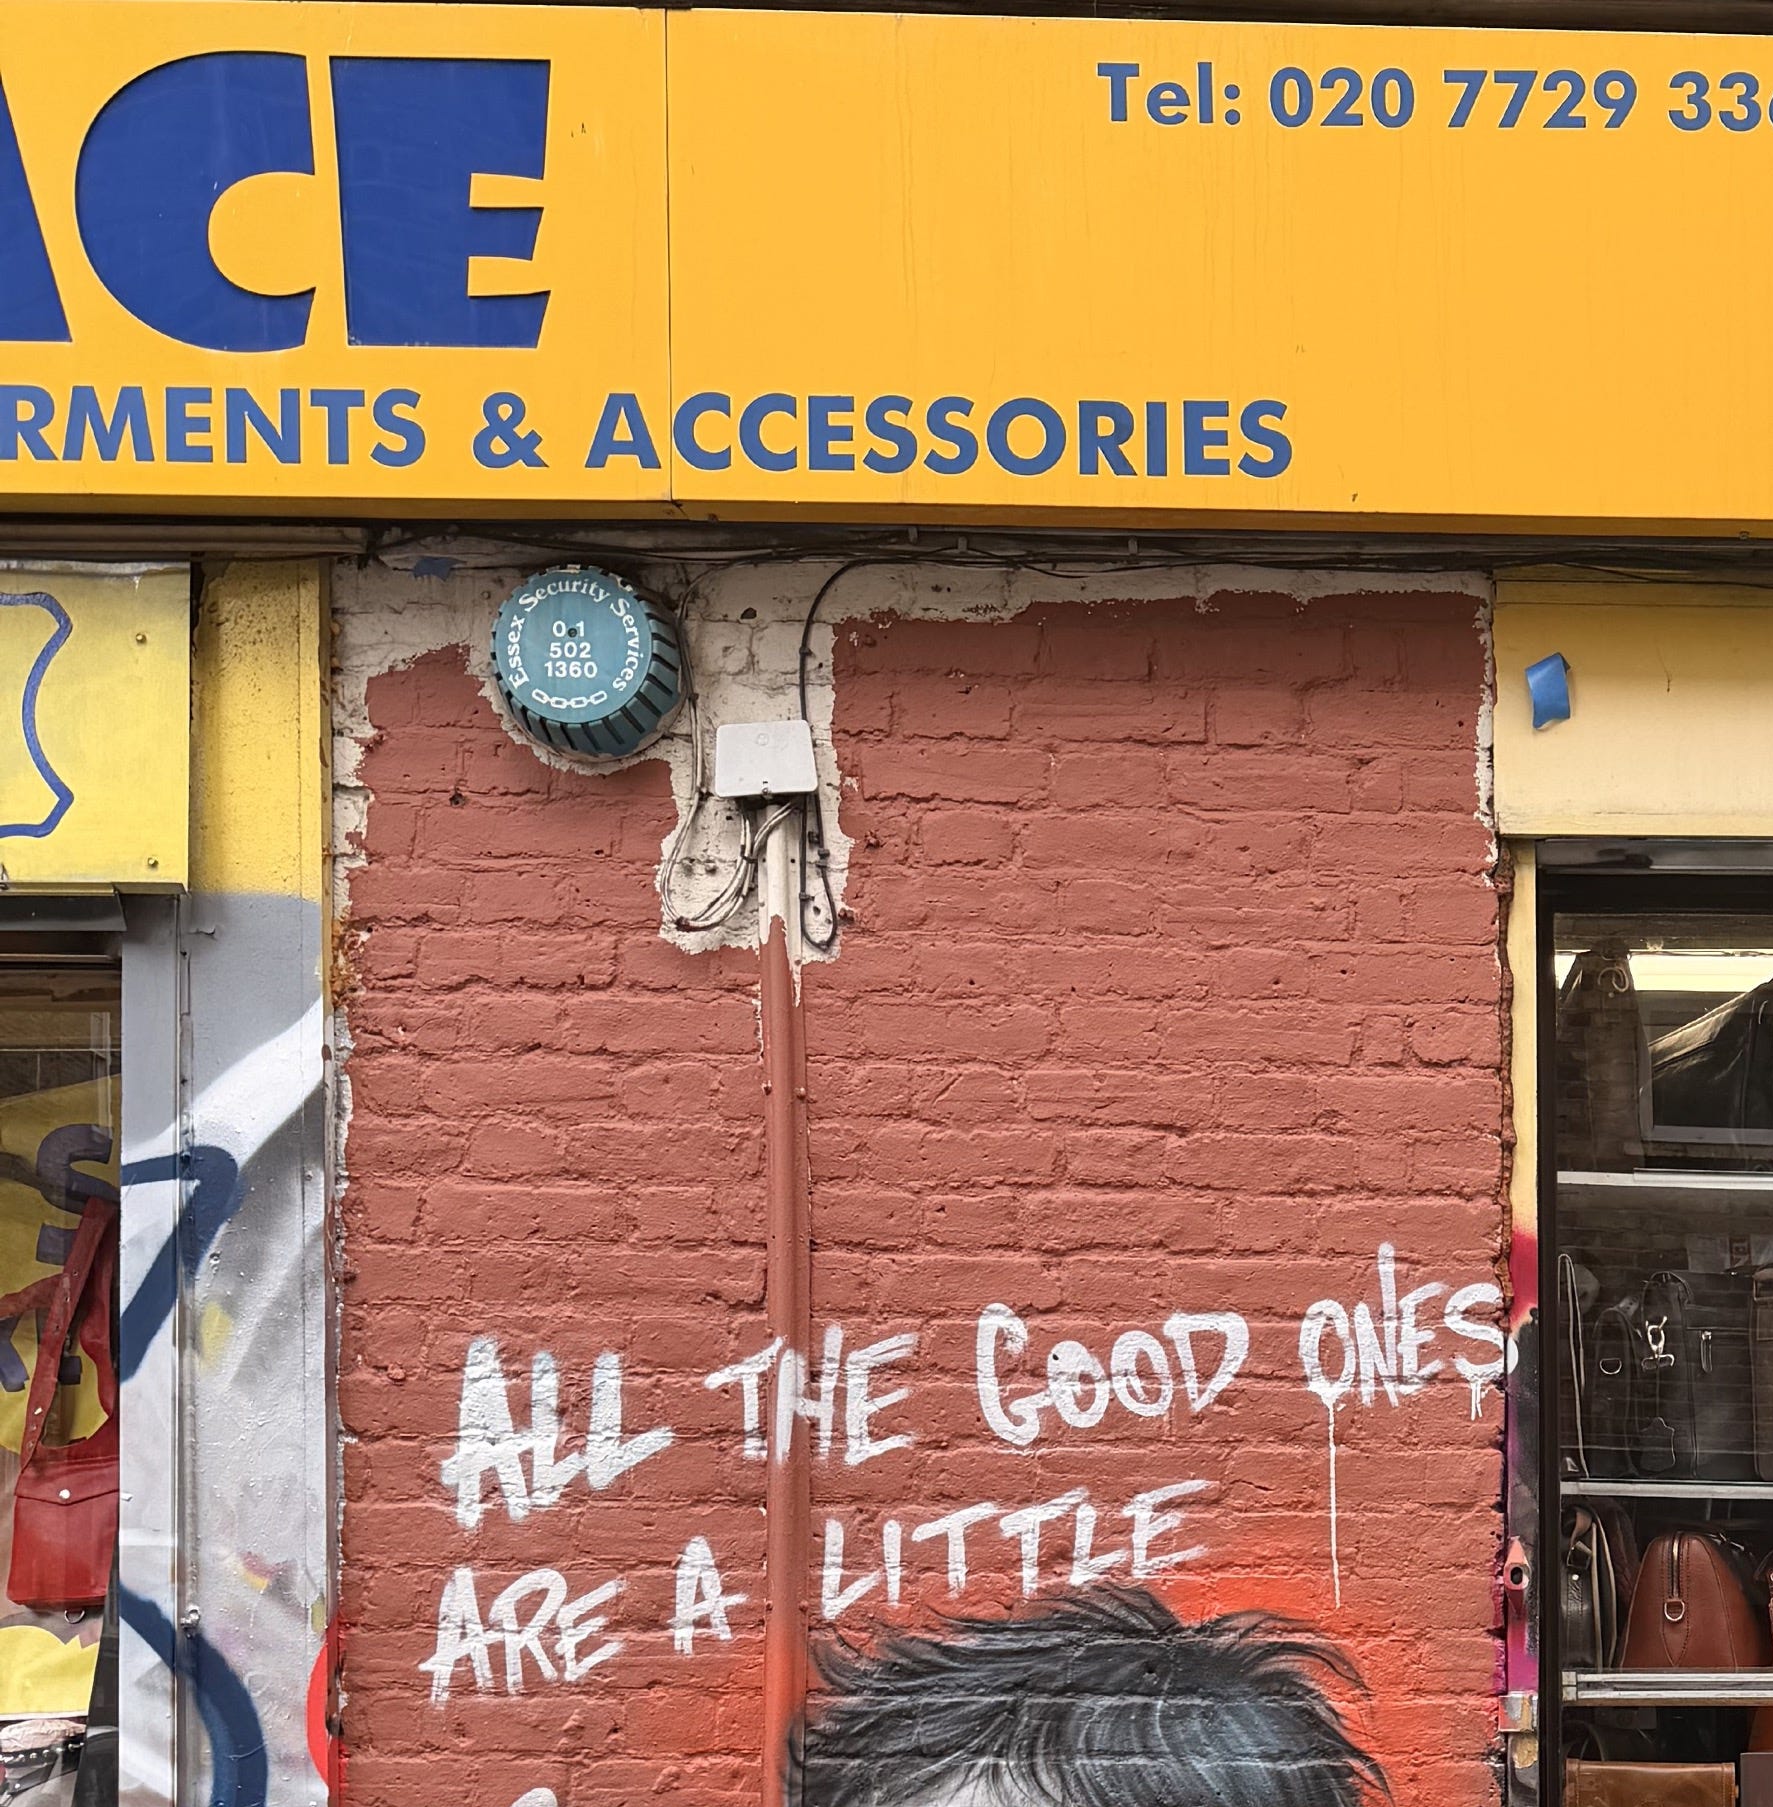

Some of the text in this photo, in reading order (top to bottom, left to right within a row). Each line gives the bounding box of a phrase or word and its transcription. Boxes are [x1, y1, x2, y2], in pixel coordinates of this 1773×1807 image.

[1097, 62, 1241, 126] Tel:
[1268, 66, 1415, 129] 020
[1442, 69, 1637, 130] 7729
[0, 384, 1293, 478] RMENTS & ACCESSORIES
[506, 578, 644, 693] Essex Security Services
[544, 661, 598, 679] 1360
[549, 642, 592, 659] 502
[440, 1241, 1519, 1528] ALL THE GOOD ONES
[417, 1479, 1221, 1706] ARE A LITTLE
